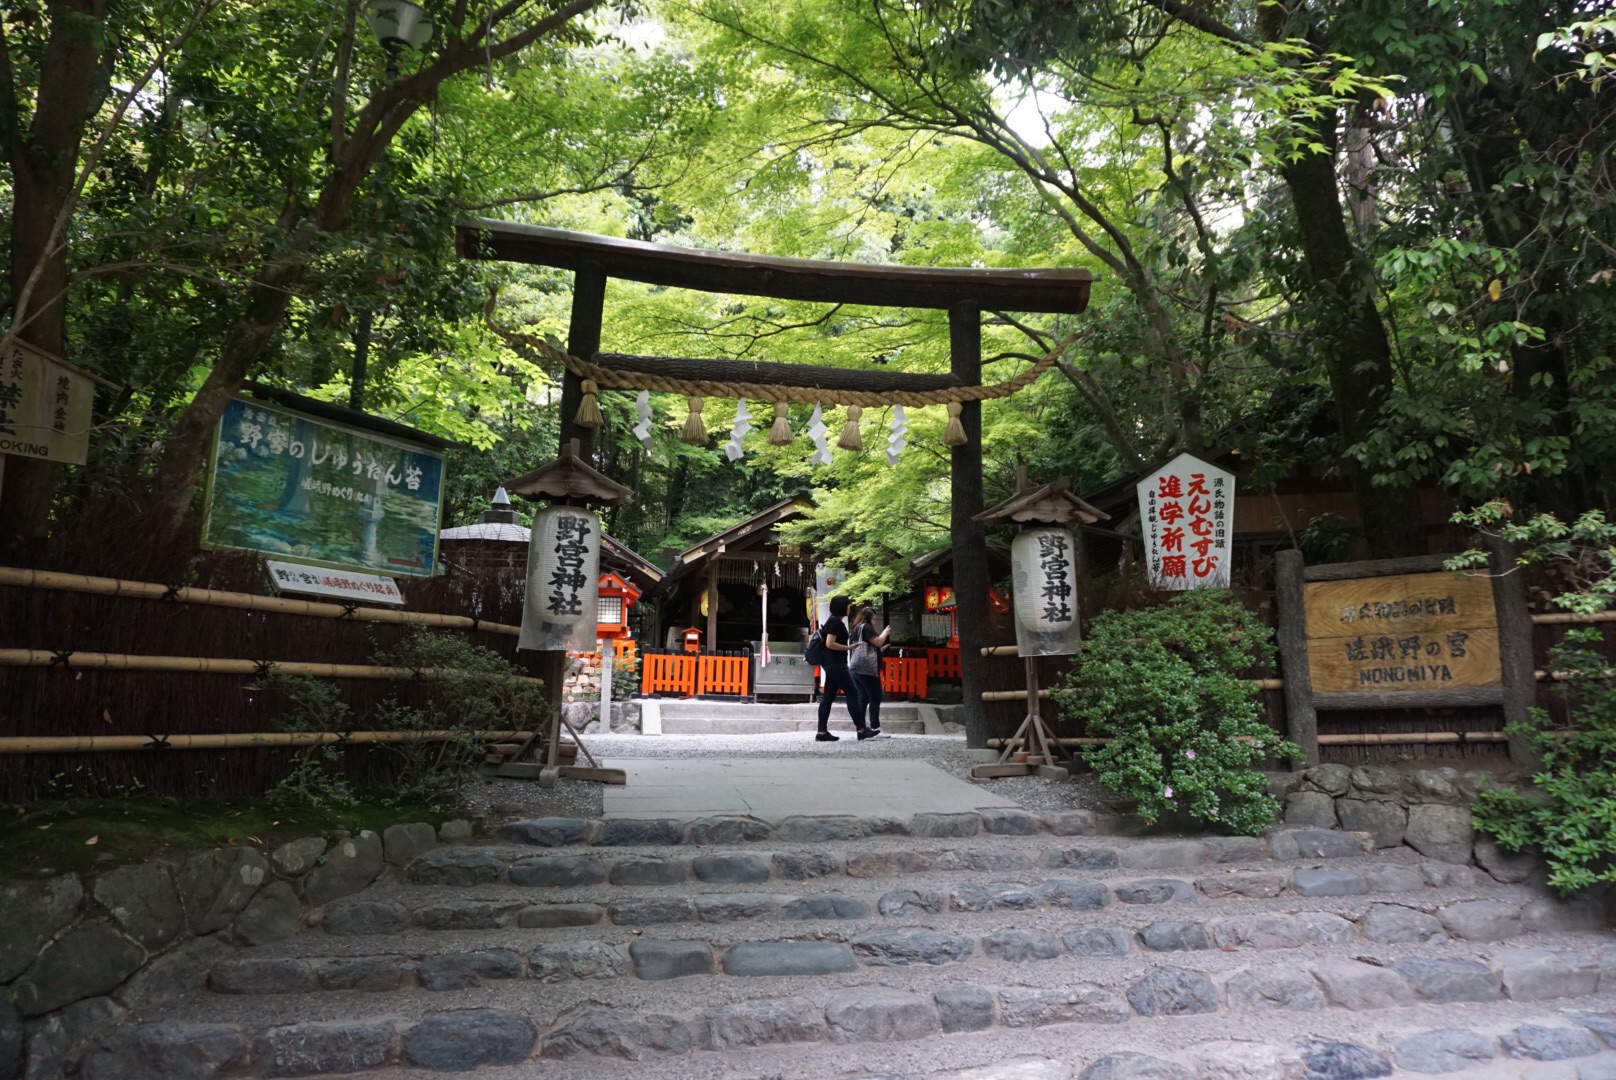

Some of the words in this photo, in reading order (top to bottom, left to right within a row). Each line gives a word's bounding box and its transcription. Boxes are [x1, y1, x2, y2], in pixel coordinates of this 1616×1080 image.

[239, 421, 423, 491] 野宮のじゅうたん苔
[546, 515, 591, 617] 野宮神社
[1158, 474, 1187, 579] 進学祈願
[1187, 473, 1219, 578] えんむすび
[1037, 534, 1073, 623] 野宮神社
[1359, 664, 1453, 685] NONOMIYA
